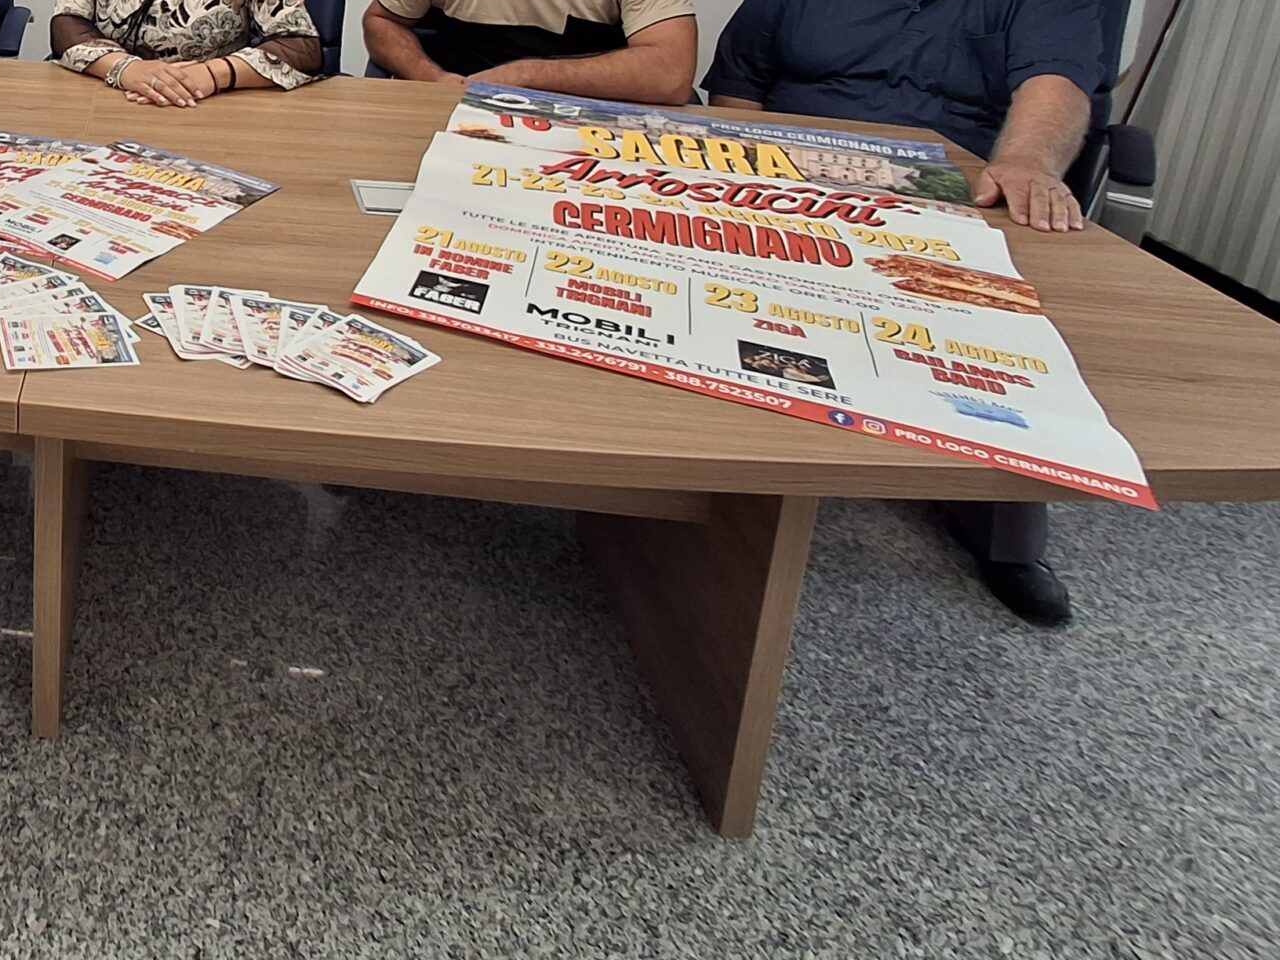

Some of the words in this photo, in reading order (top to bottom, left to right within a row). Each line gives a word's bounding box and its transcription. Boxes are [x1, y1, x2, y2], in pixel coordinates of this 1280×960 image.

[577, 126, 807, 182] SAGRA
[711, 122, 741, 133] PRO
[745, 127, 784, 138] LOCO
[786, 131, 893, 155] CERMIGNANO
[896, 148, 929, 160] APS
[414, 226, 455, 249] 21
[454, 239, 528, 264] AGOSTO
[552, 200, 853, 268] CERMIGNANO
[699, 204, 843, 240] AGOSTO
[849, 228, 961, 261] 2025
[413, 244, 433, 257] IN
[437, 248, 515, 275] NOMINE
[429, 258, 491, 280] FABER
[461, 210, 505, 224] TUTTE
[509, 219, 527, 228] LE
[531, 224, 569, 236] SERE
[574, 233, 660, 255] APERTURA
[666, 251, 724, 267] STAND
[729, 264, 872, 296] GASTRONOMICI
[877, 293, 917, 304] ORE
[530, 237, 686, 272] INTRATTENIMENTO
[691, 269, 783, 290] MUSICALE
[789, 289, 828, 300] ORE
[543, 250, 595, 279] 22
[595, 267, 677, 296] AGOSTO
[413, 286, 481, 312] FABER
[555, 286, 652, 318] TRIGNANI
[567, 278, 642, 303] MOBILI
[704, 283, 759, 313] 23
[769, 302, 861, 333] AGOSTO
[525, 303, 675, 345] MOBILI
[540, 319, 658, 348] TRIGNANI
[872, 316, 936, 352] 24
[944, 338, 1049, 374] AGOSTO
[554, 333, 592, 346] BUS
[597, 342, 689, 367] NAVETTA
[695, 362, 759, 384] TUTTE
[766, 377, 790, 391] LE
[796, 385, 853, 405] SERE
[893, 348, 1035, 388] BAILAMOS
[931, 367, 1007, 395] BAND
[370, 300, 415, 315] INFO:
[663, 369, 792, 409] 388.7523507
[894, 428, 932, 446] PRO
[936, 438, 991, 459] LOCO
[993, 454, 1140, 499] CERMIGNANO
